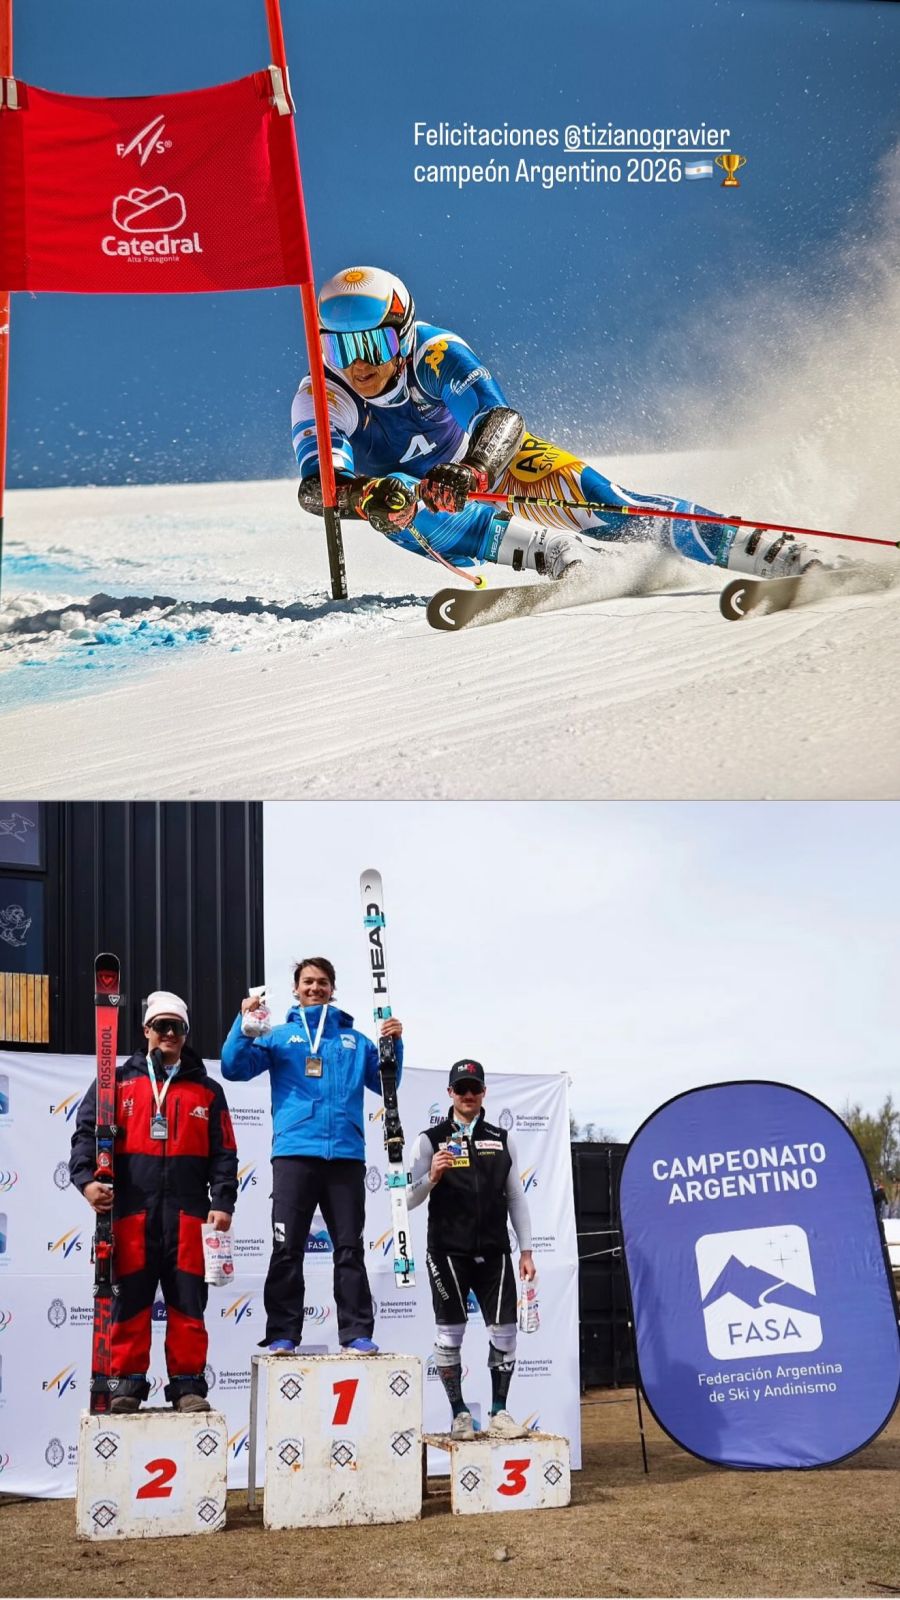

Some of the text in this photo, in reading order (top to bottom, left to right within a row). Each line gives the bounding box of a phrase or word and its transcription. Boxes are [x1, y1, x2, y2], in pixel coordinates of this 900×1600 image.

[101, 232, 203, 256] Catedral
[143, 256, 180, 264] Patagonia
[400, 434, 437, 463] 4
[525, 497, 564, 508] LEKI
[489, 524, 503, 557] HEAD
[720, 529, 734, 562] HEAD
[102, 1026, 113, 1090] ROSSIGNOL
[652, 1142, 826, 1181] CAMPEONATO
[668, 1168, 818, 1204] ARGENTINO
[435, 1278, 450, 1301] team
[727, 1317, 802, 1346] FASA
[697, 1362, 843, 1387] Federación Argentina
[332, 1379, 359, 1426] 1
[709, 1382, 837, 1403] de Ski y Andinismo
[136, 1458, 177, 1499] 2
[497, 1459, 531, 1496] 3
